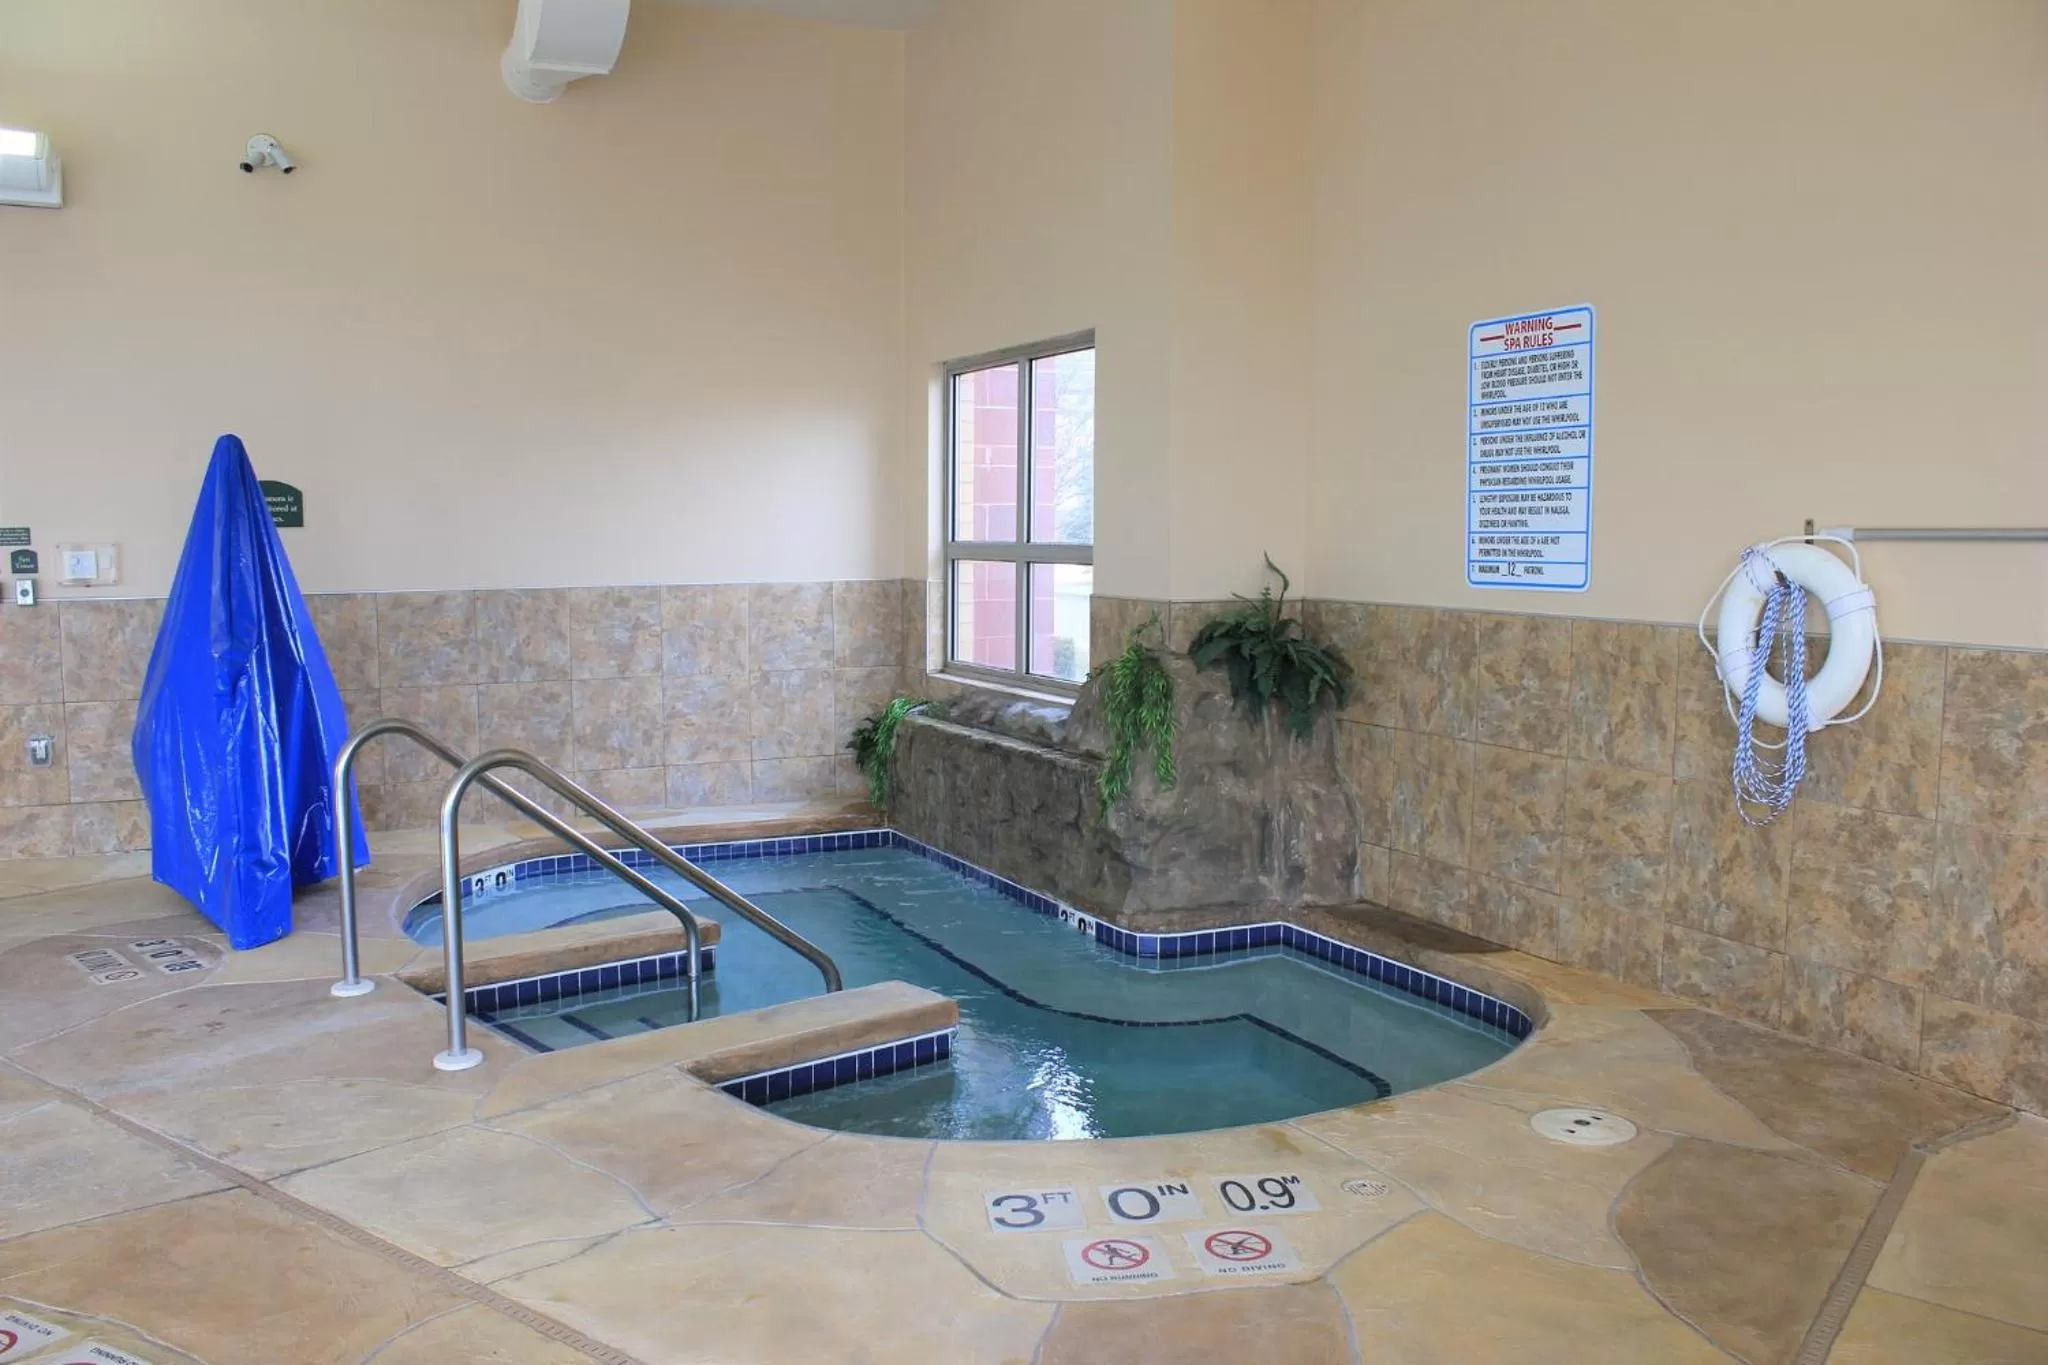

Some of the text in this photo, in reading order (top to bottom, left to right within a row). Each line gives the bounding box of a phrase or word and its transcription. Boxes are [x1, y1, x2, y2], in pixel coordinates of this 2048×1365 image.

[1504, 317, 1553, 335] WARNING
[1504, 333, 1553, 351] SPA RULES
[992, 1194, 1045, 1228] 3
[1041, 1192, 1071, 1204] FT
[1157, 1183, 1189, 1196] IN
[1220, 1178, 1295, 1211] 0.9
[1281, 1175, 1300, 1184] M
[1110, 1272, 1158, 1280] RUNNING
[1241, 1263, 1286, 1272] DIVING
